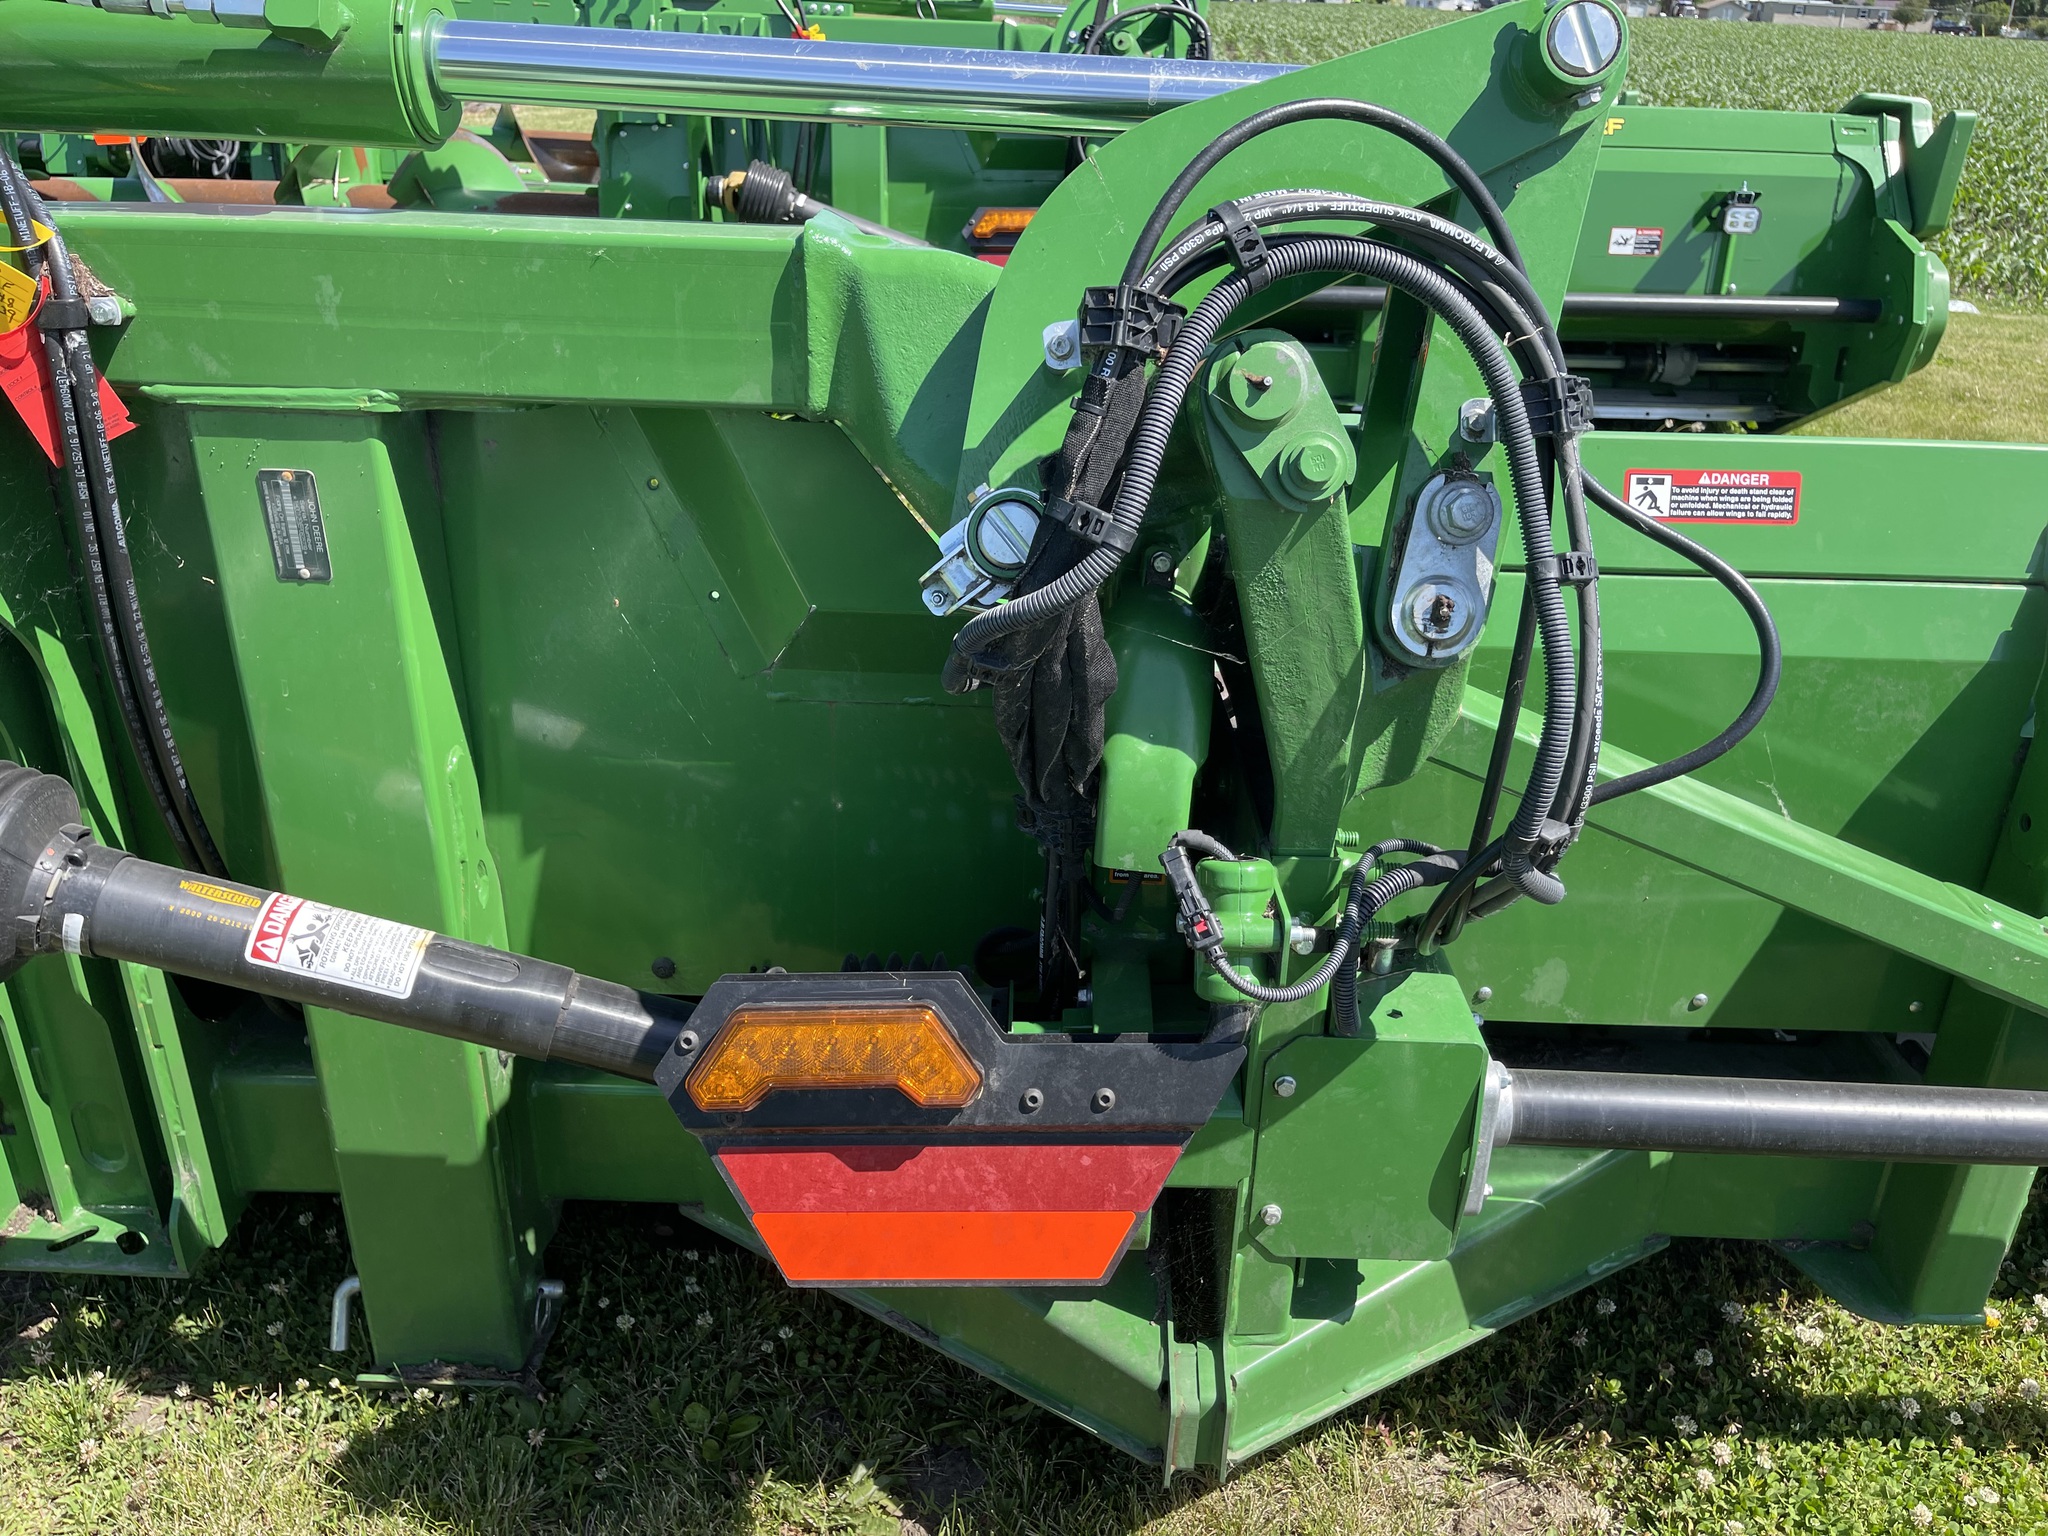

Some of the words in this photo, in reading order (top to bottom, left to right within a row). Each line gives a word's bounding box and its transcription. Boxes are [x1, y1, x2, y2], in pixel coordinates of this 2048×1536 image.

[1426, 217, 1497, 260] ALFAGOMMA
[64, 411, 74, 422] 22
[1711, 473, 1769, 485] DANGER
[1700, 487, 1719, 495] injury
[1719, 495, 1738, 503] wings
[1752, 495, 1770, 503] being
[1760, 503, 1792, 511] hydraulic
[1725, 510, 1745, 518] wings
[1767, 510, 1792, 518] rapidly.
[306, 498, 318, 522] JOHN
[312, 524, 323, 553] DEERE
[179, 880, 261, 908] WALTERSCHEID
[265, 893, 295, 934] DANG
[341, 932, 355, 952] KEEP
[318, 931, 337, 968] ROTATING
[346, 948, 355, 961] NOT
[343, 962, 350, 972] DO
[393, 976, 401, 987] DO
